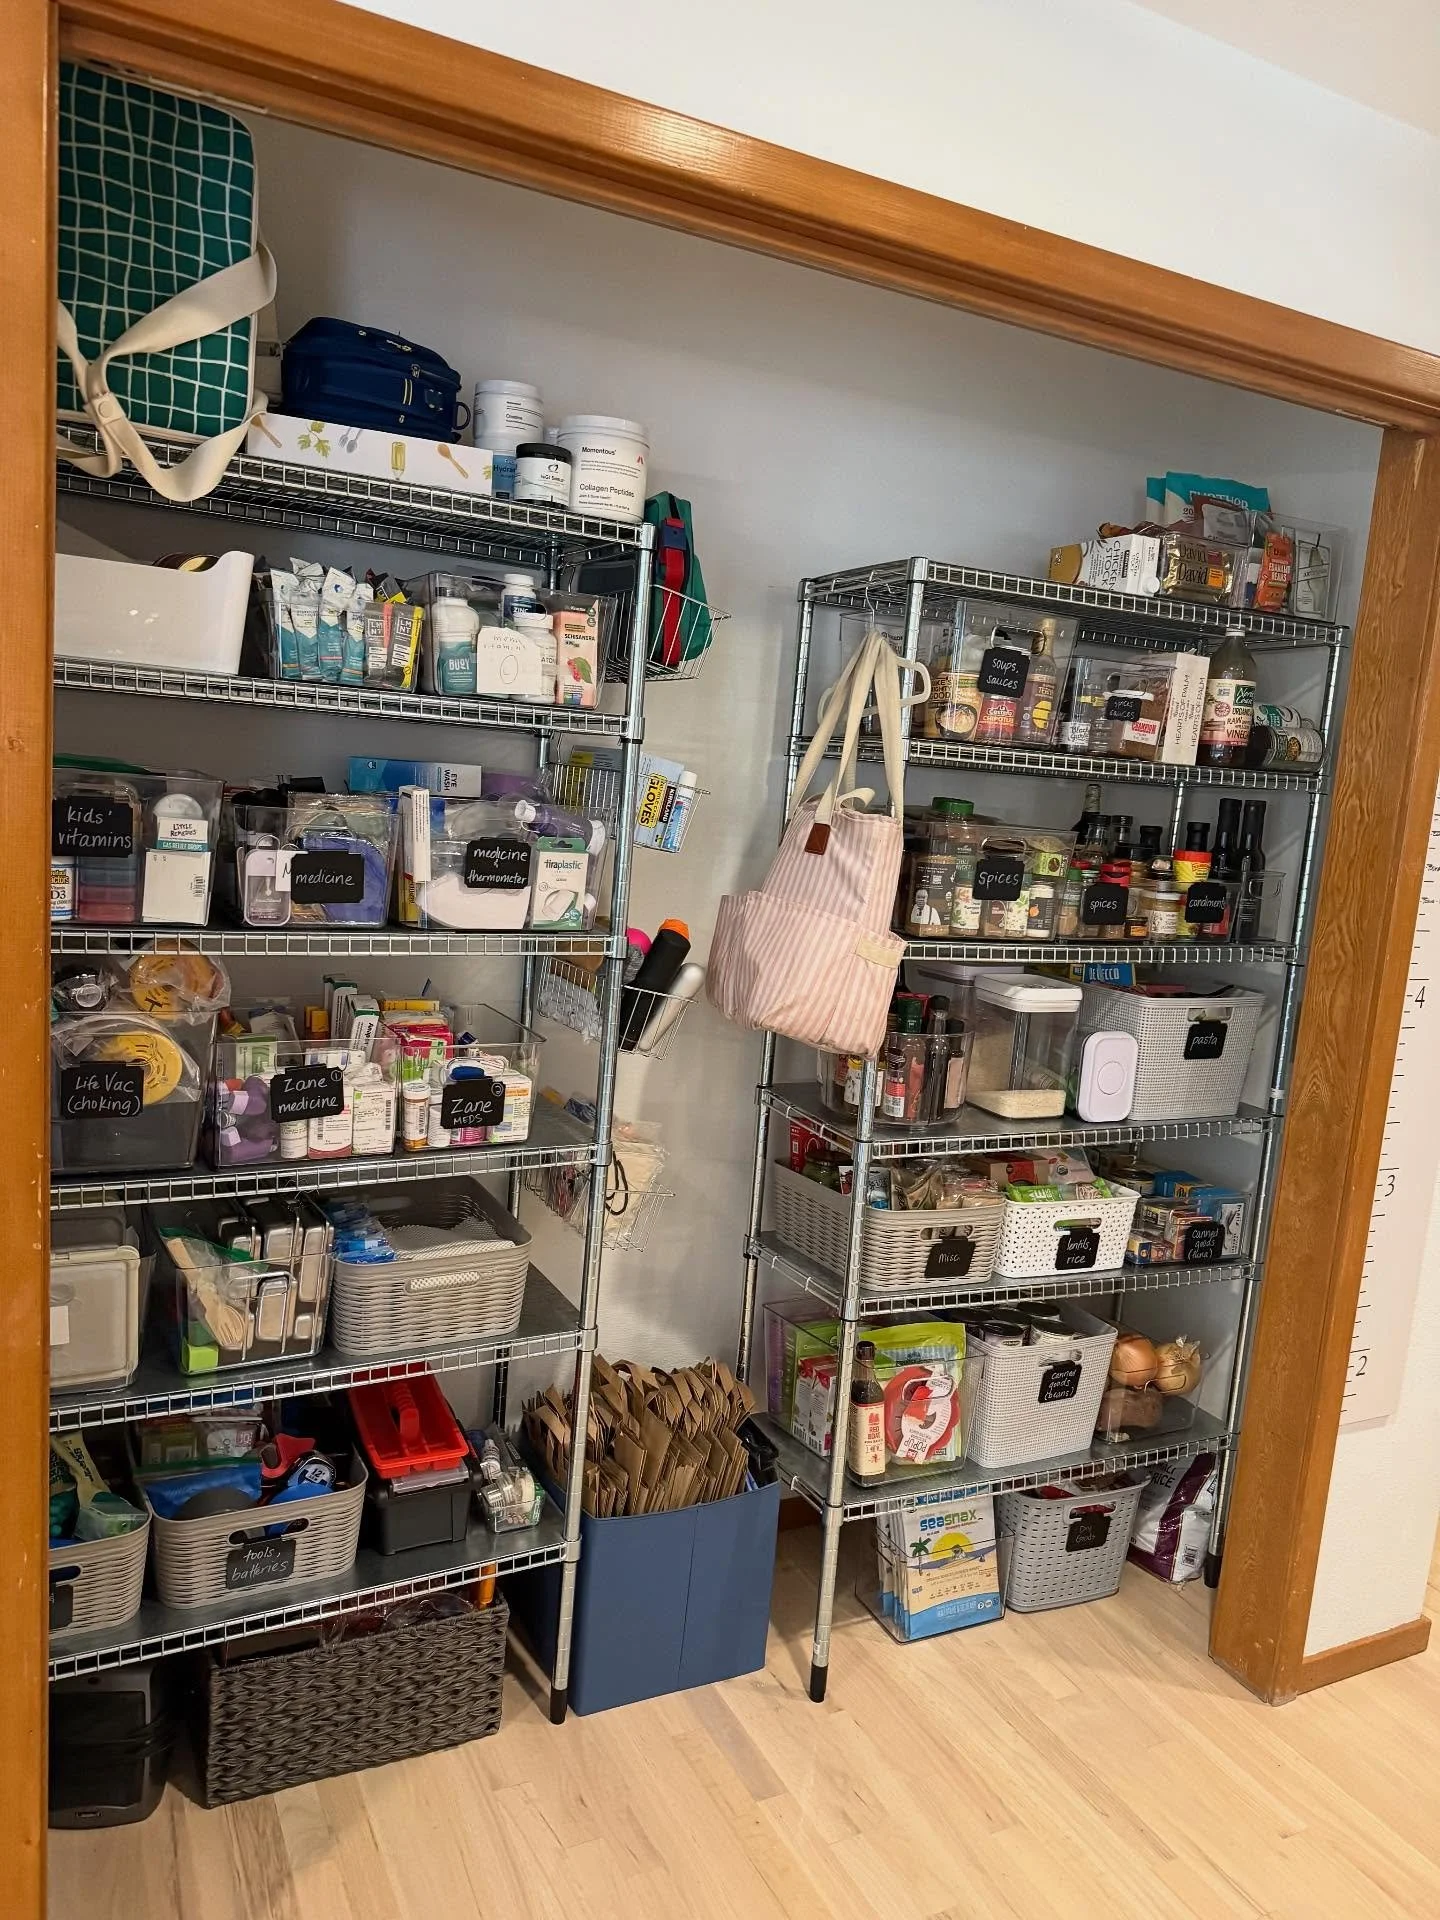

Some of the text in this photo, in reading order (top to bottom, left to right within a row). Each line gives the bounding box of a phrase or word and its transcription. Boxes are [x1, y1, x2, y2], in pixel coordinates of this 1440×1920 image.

[579, 483, 608, 494] Collagen
[609, 486, 635, 498] Peptides
[1101, 547, 1112, 588] STOCK
[1108, 540, 1121, 591] CHICKEN
[1177, 562, 1208, 584] David
[986, 674, 1019, 690] sauces
[1175, 713, 1184, 745] HEARTS
[1227, 716, 1242, 724] RAW
[450, 773, 458, 788] EYE
[640, 778, 660, 825] GLOVES
[662, 788, 676, 822] KIRKLAND
[67, 806, 113, 825] kids'
[58, 828, 132, 848] vitamins
[473, 847, 528, 862] medicine
[544, 858, 584, 870] tiraplastic
[295, 868, 355, 886] medicine
[467, 868, 528, 886] thermometer
[978, 872, 1019, 890] Spices
[50, 890, 66, 900] D3
[1090, 896, 1118, 910] spices
[1414, 986, 1426, 1008] 4
[1190, 1032, 1218, 1052] pasta
[283, 1078, 328, 1093] Zane
[67, 1094, 141, 1116] (choking)
[278, 1096, 339, 1114] medicine
[450, 1098, 494, 1114] Zane
[453, 1114, 484, 1126] MEDS
[1384, 1174, 1396, 1197] 3
[1066, 1254, 1086, 1264] rice
[1356, 1356, 1368, 1376] 2
[1048, 1378, 1070, 1389] goods
[1152, 1472, 1176, 1489] RICE
[920, 1509, 977, 1532] seasnax
[232, 1560, 288, 1582] batteries
